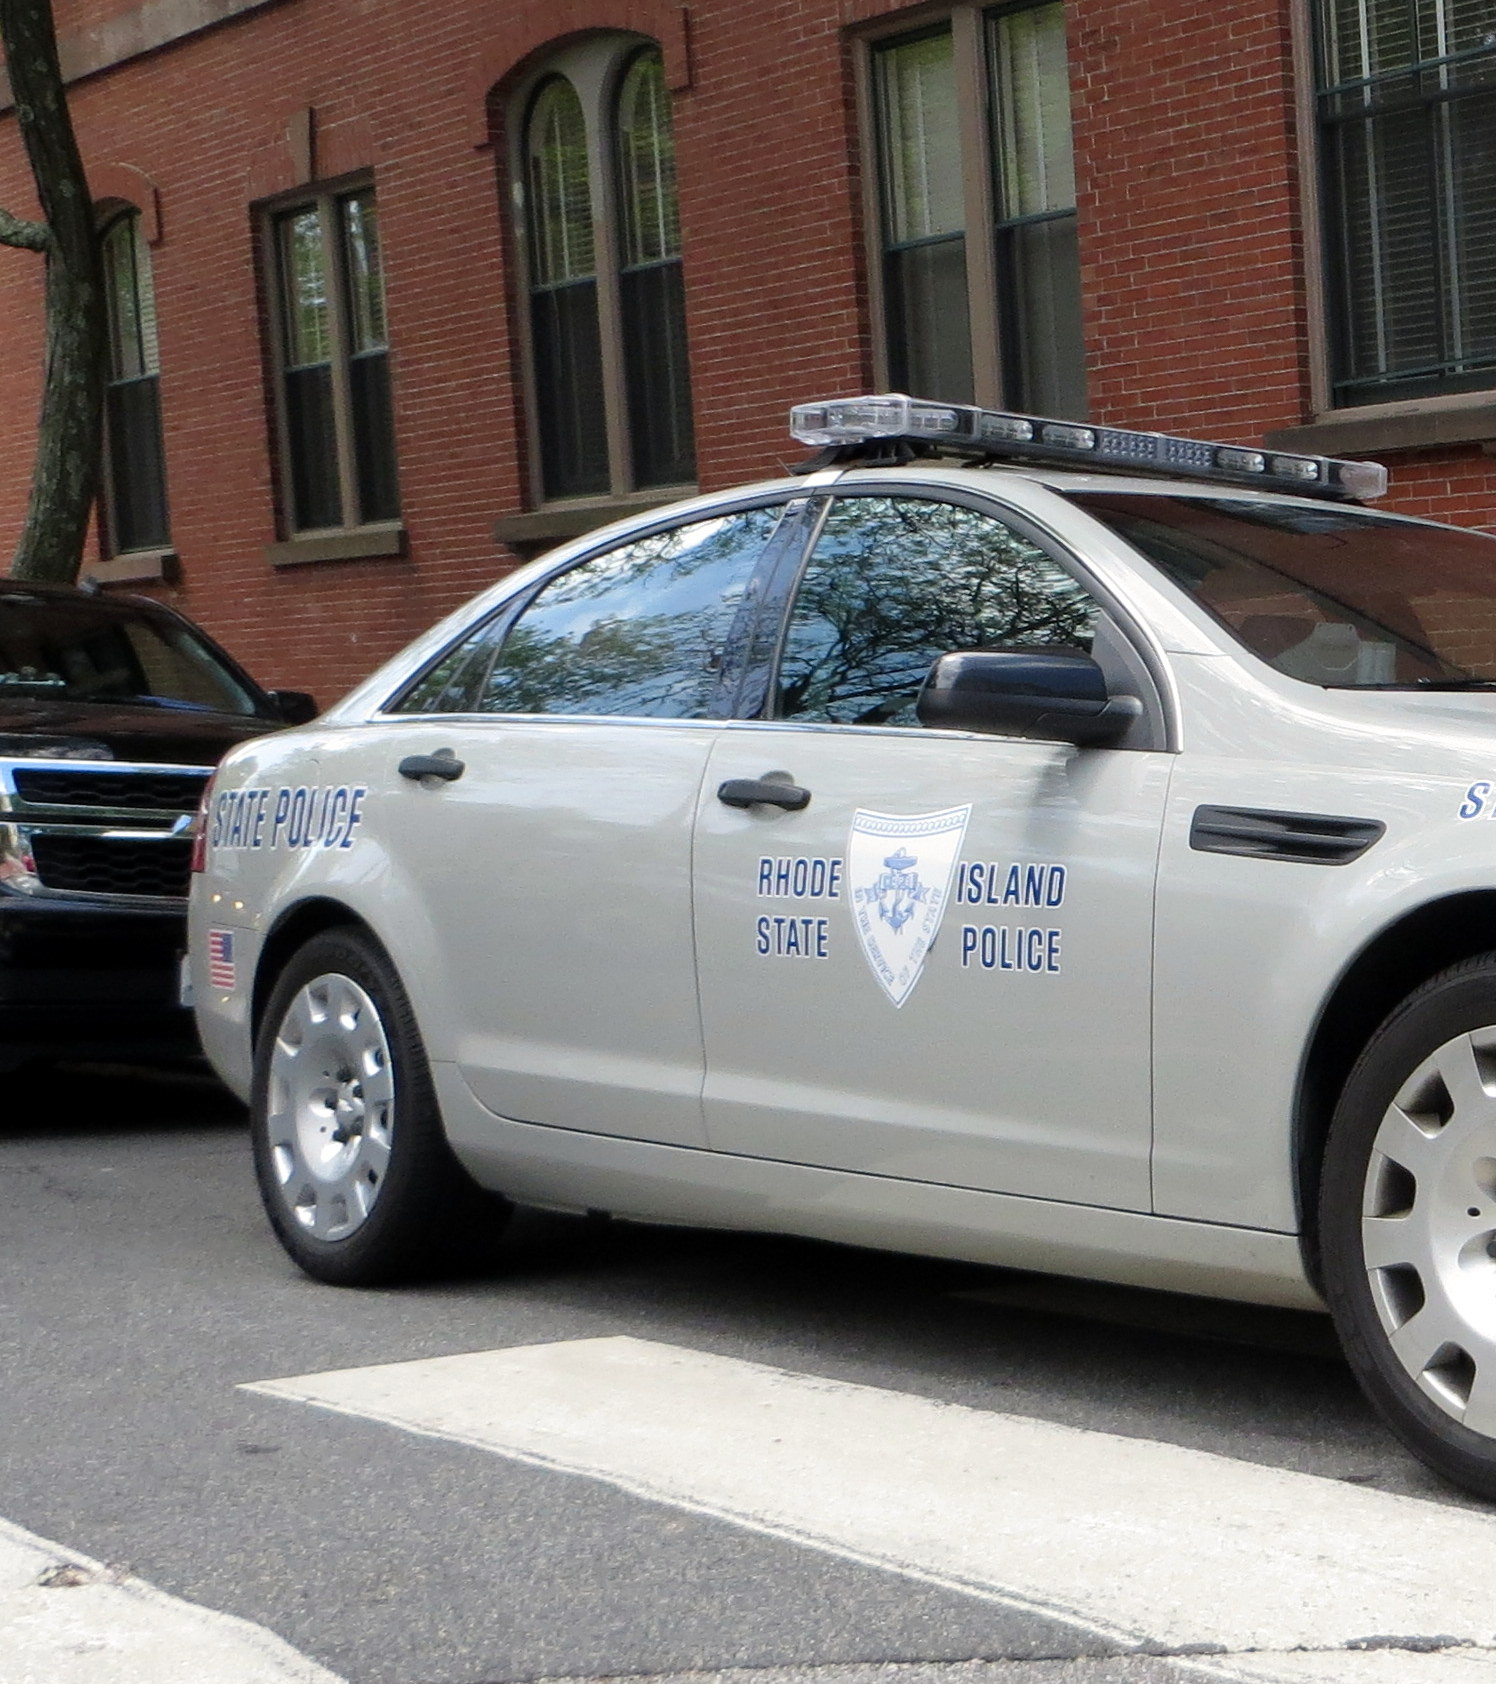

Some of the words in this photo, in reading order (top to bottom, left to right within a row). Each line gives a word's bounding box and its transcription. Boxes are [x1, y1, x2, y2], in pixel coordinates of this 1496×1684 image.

[212, 788, 270, 849] STATE
[271, 786, 368, 850] POLICE
[758, 857, 842, 898] RHODE
[957, 862, 1066, 908] ISLAND
[757, 916, 829, 958] STATE
[961, 925, 1061, 973] POLICE
